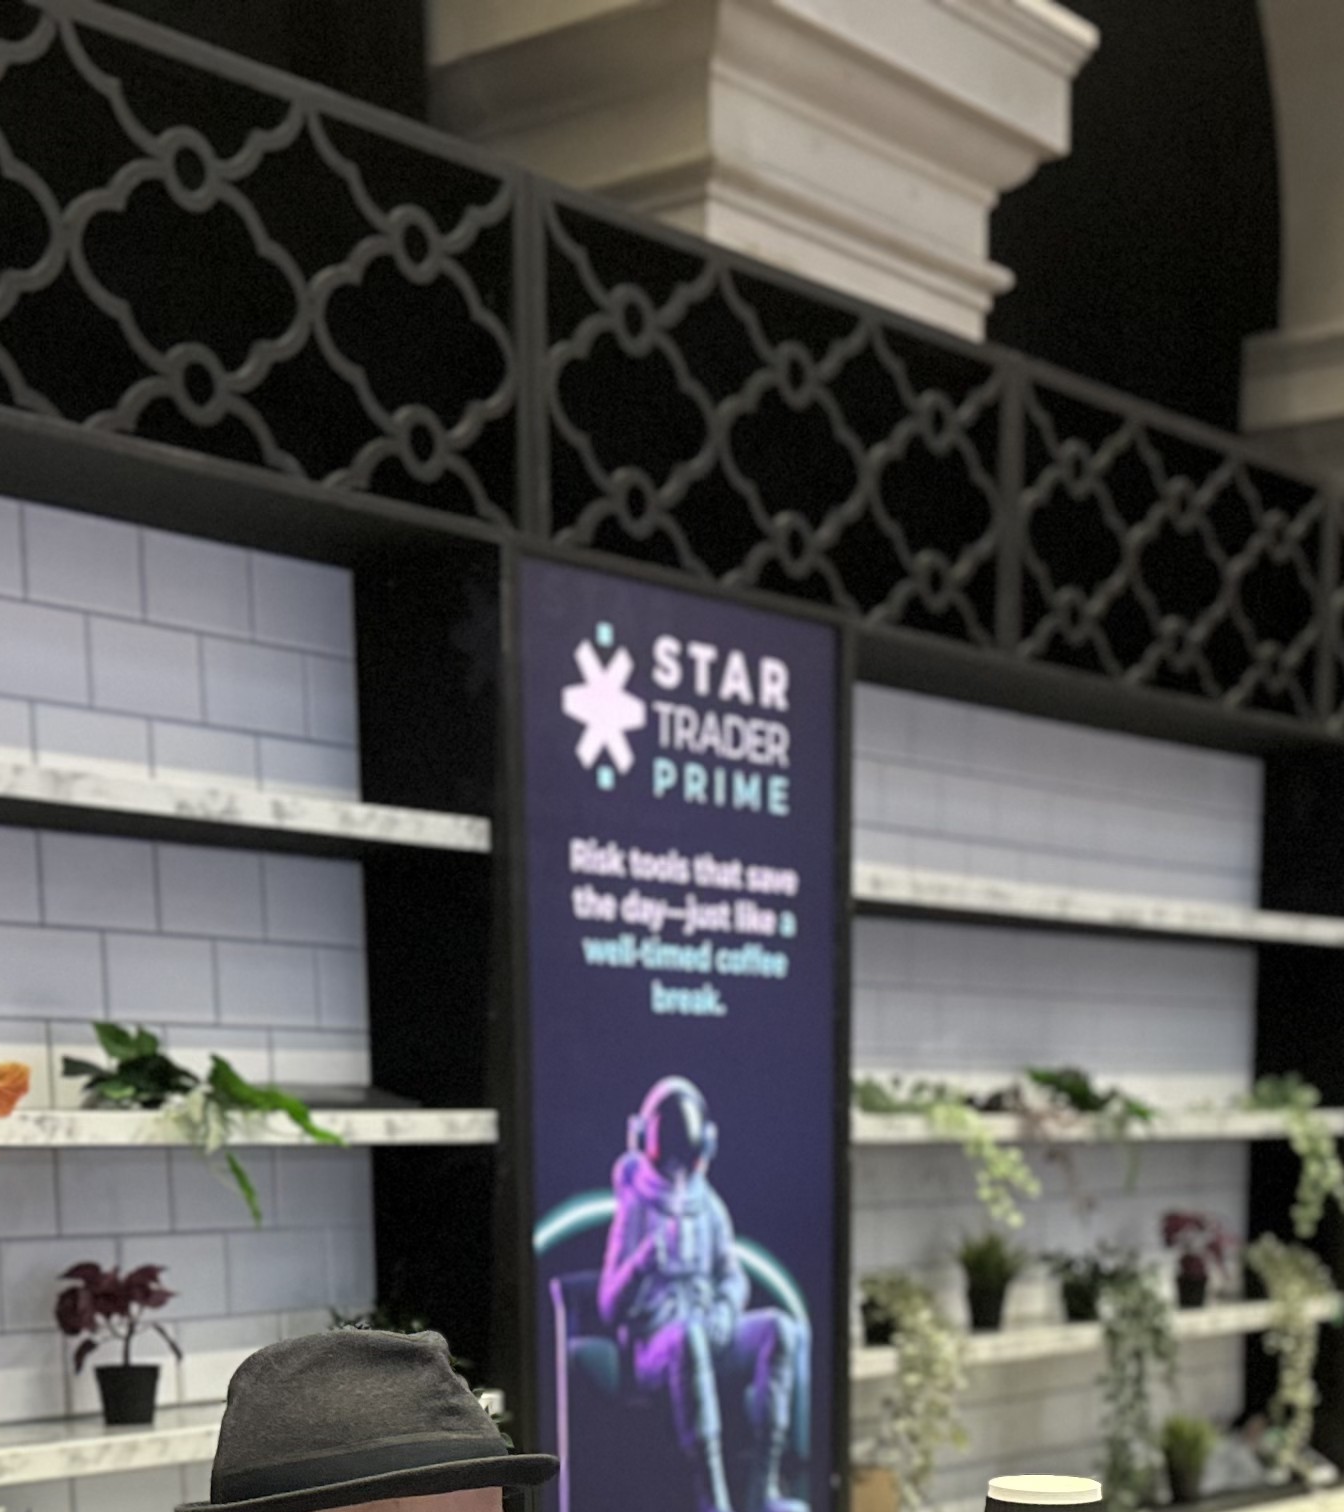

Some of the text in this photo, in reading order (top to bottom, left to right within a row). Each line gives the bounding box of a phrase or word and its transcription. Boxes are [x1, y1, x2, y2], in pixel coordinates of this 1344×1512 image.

[652, 635, 789, 710] STAR
[653, 702, 789, 767] TRADER
[653, 758, 789, 816] PRIME
[569, 837, 799, 897] Risk tools that save
[572, 883, 617, 923] the
[734, 899, 777, 936] like
[779, 910, 796, 938] a
[581, 932, 789, 979] well-timed coffee
[651, 978, 727, 1017] break.
